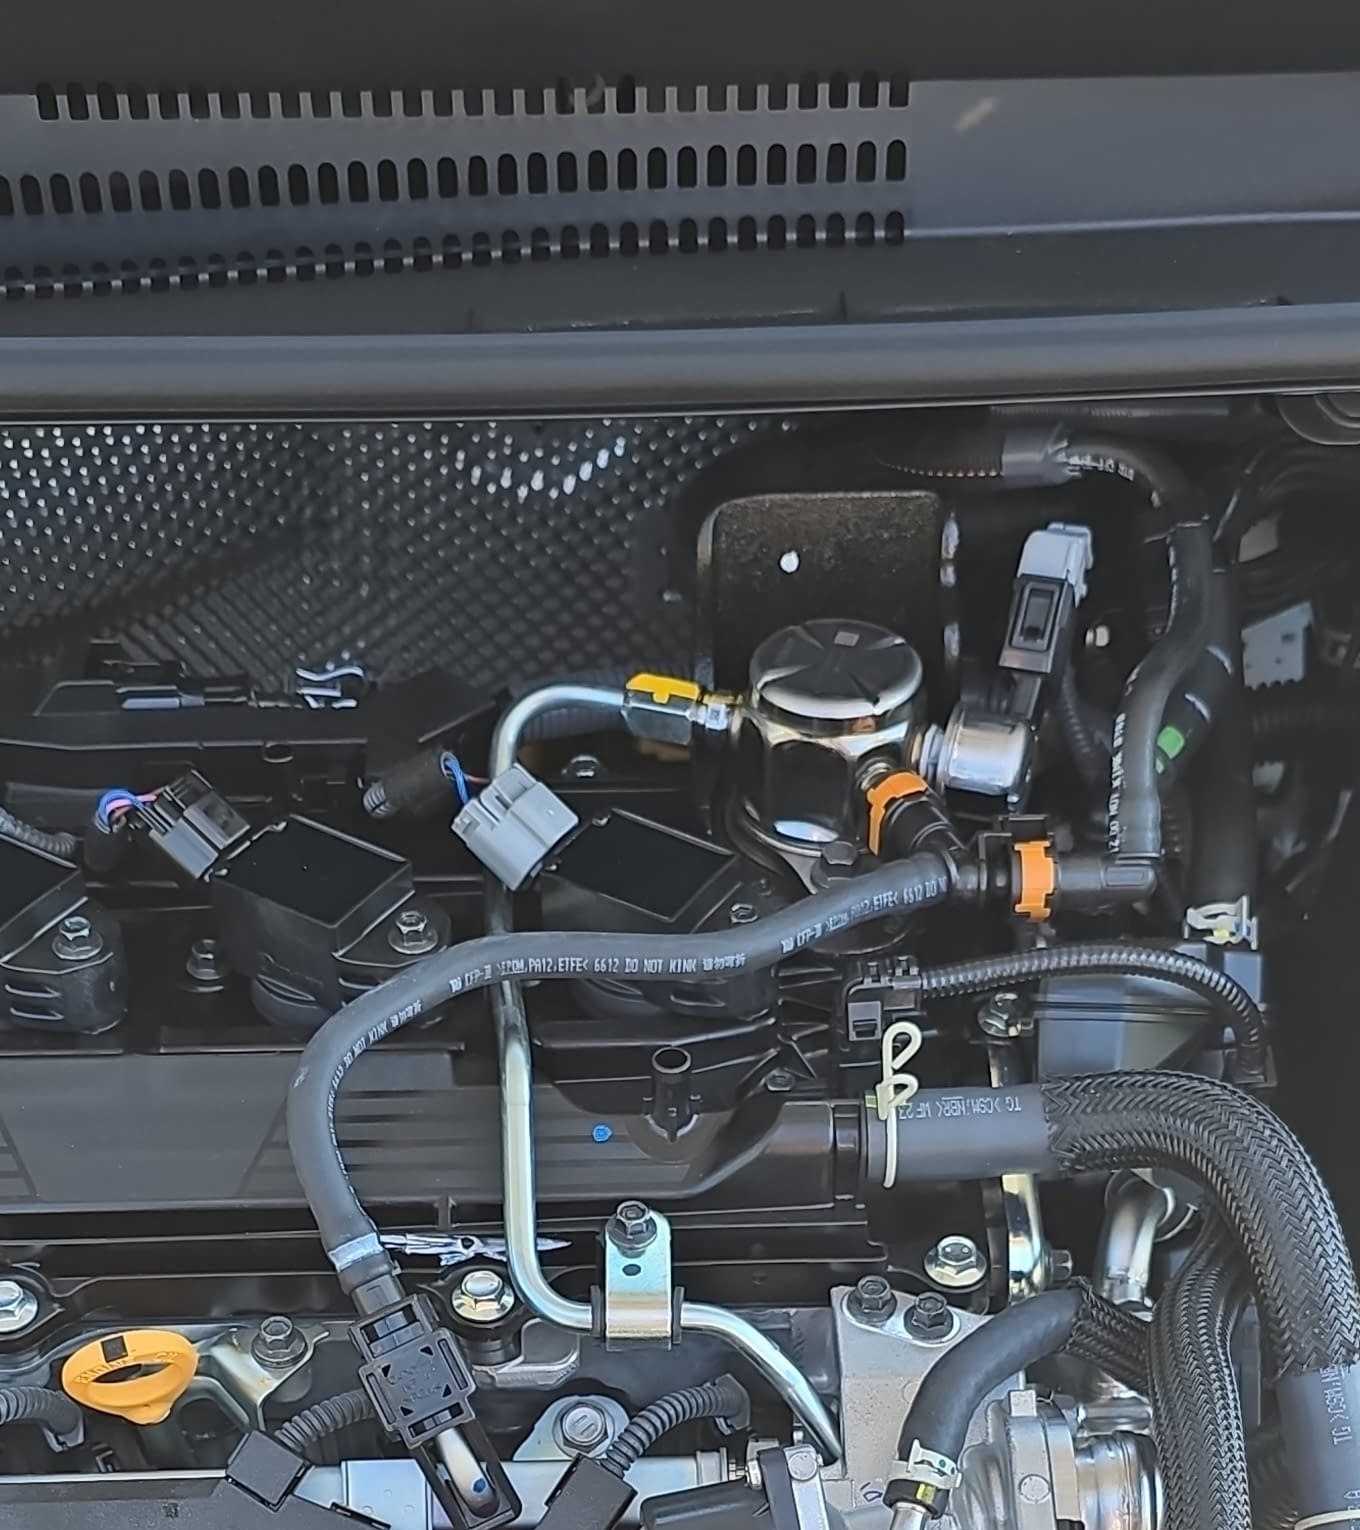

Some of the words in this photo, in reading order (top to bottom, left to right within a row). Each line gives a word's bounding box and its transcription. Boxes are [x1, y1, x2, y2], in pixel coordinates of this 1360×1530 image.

[594, 958, 618, 973] 6612
[624, 958, 638, 973] DO
[644, 957, 664, 973] NOT
[669, 958, 696, 973] KINK
[1006, 1096, 1022, 1112] TG
[1331, 1425, 1353, 1446] TG
